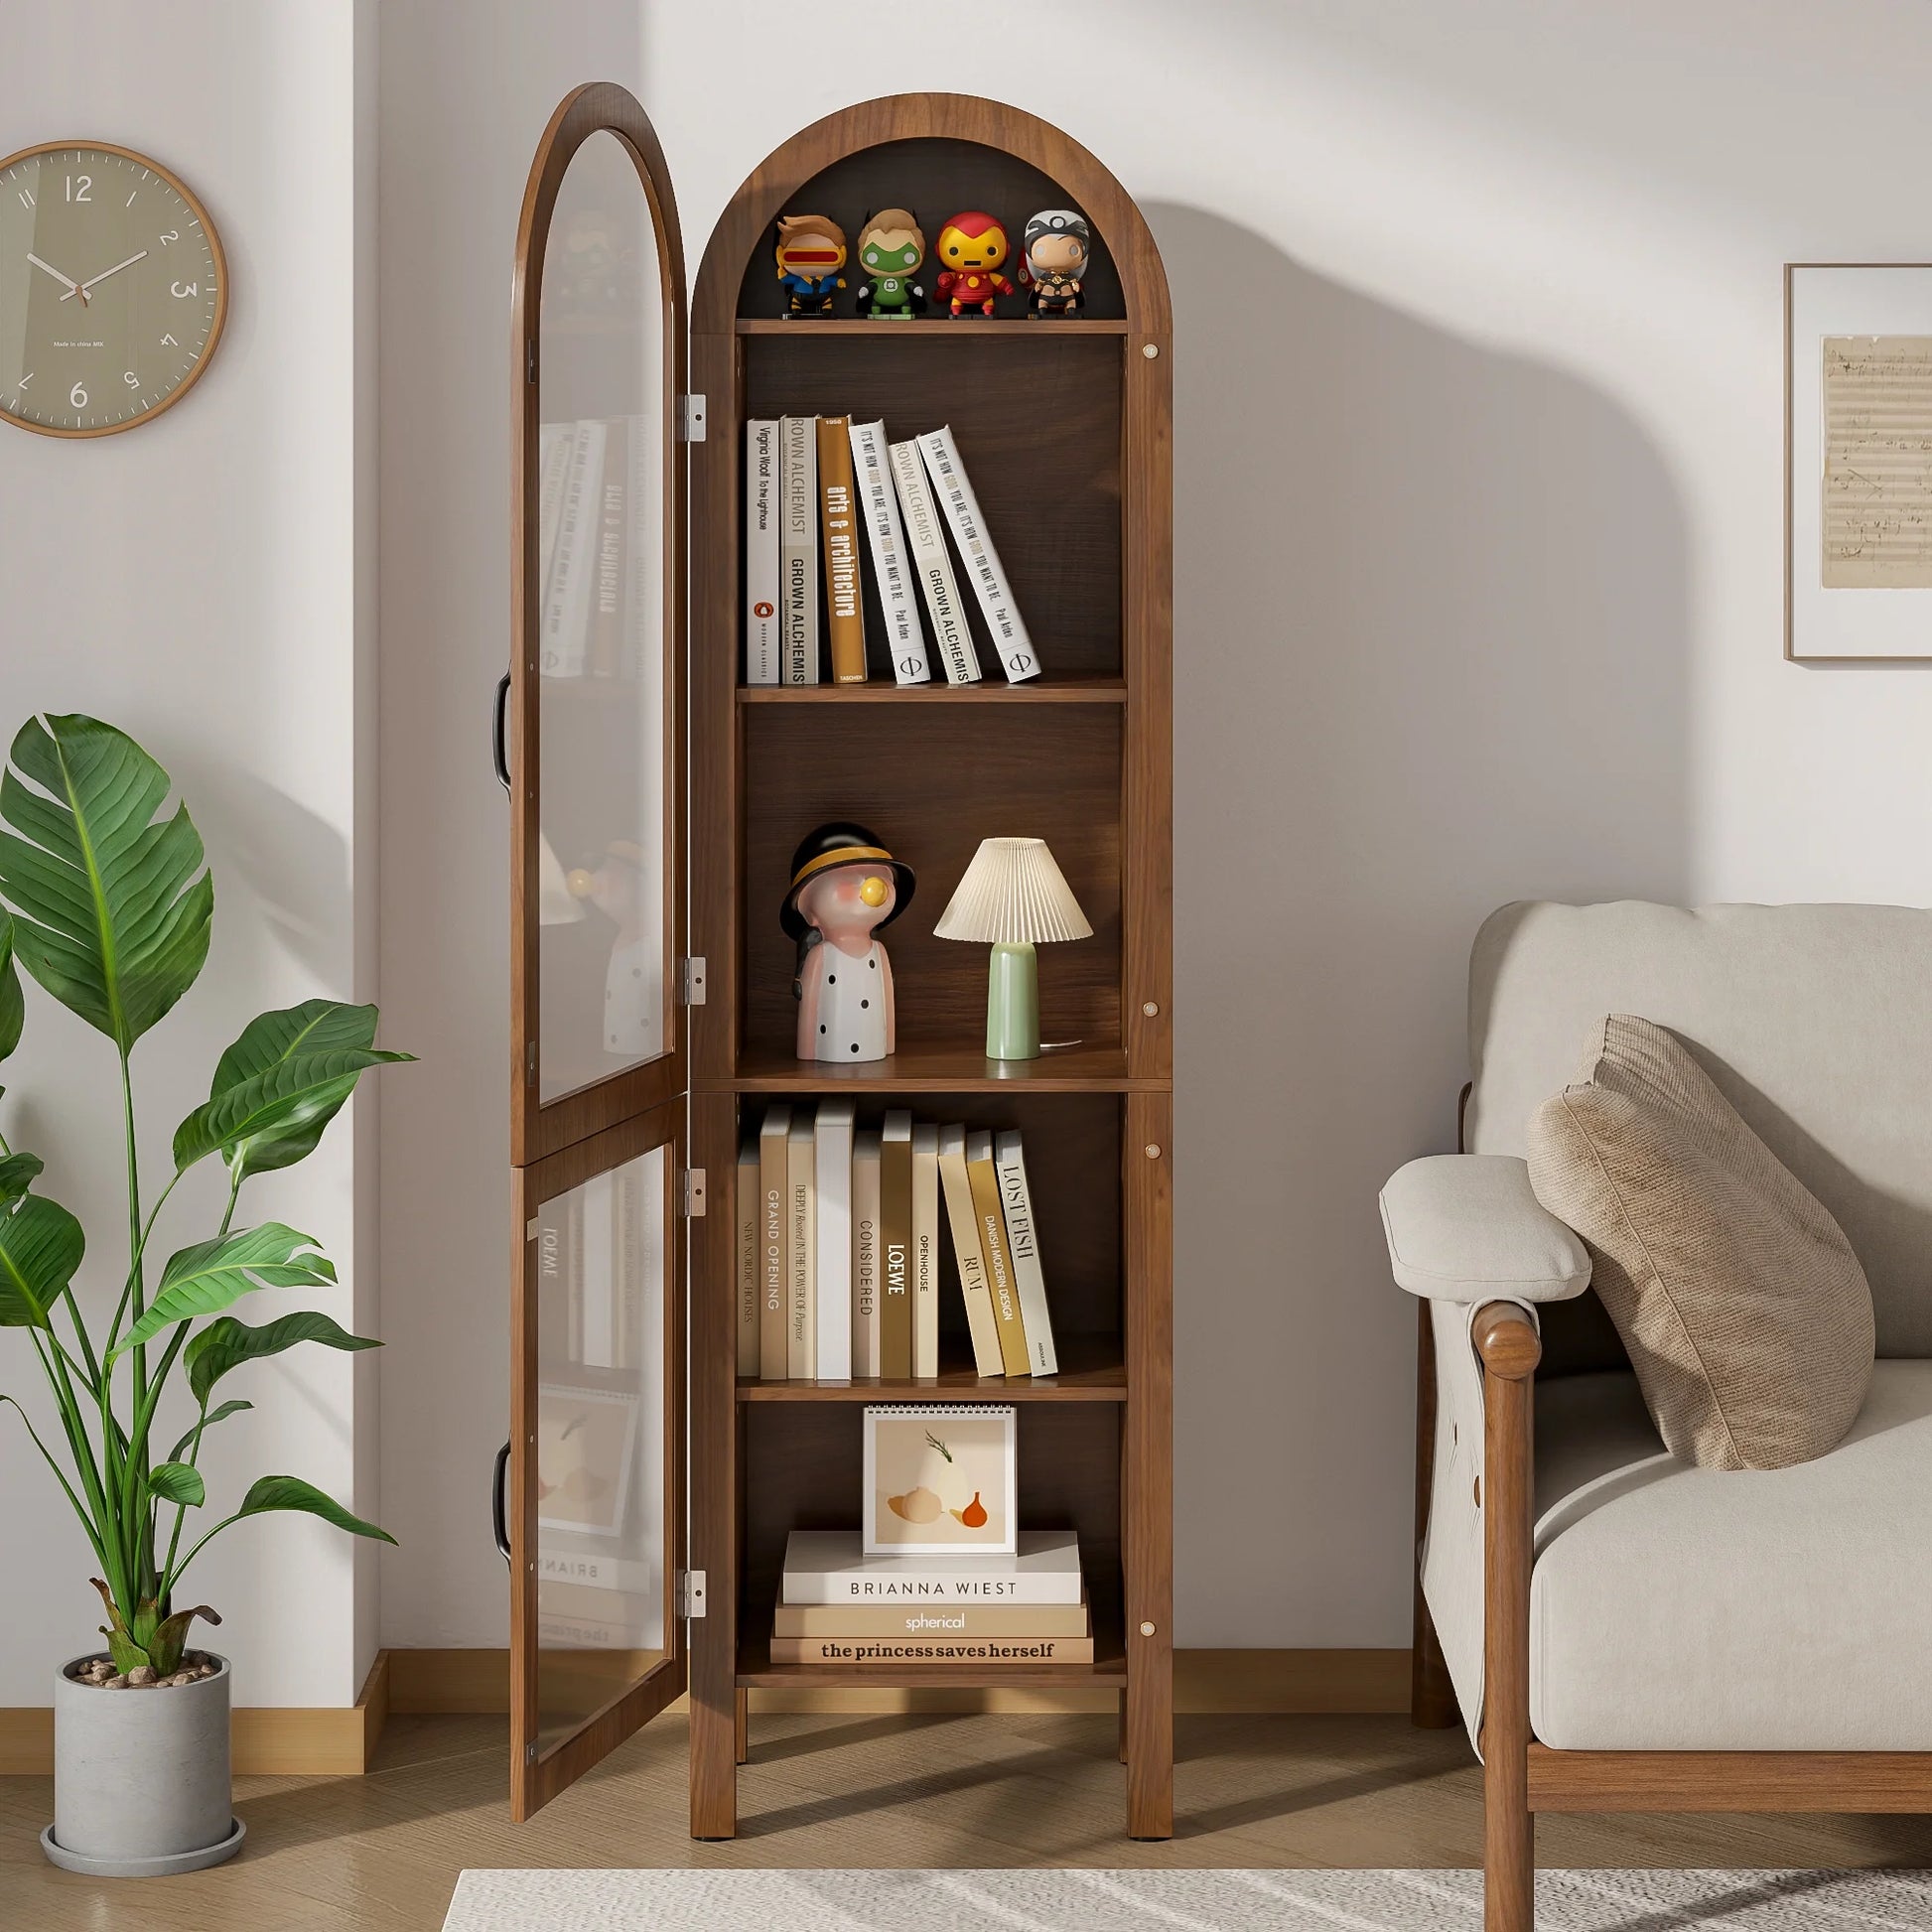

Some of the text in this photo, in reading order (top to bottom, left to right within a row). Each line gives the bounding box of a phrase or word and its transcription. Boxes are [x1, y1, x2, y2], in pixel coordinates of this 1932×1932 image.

[66, 175, 92, 203] 12
[18, 189, 36, 209] 11
[126, 191, 137, 207] 1
[159, 230, 179, 246] 2
[170, 281, 198, 299] 3
[160, 333, 179, 346] 4
[18, 372, 35, 390] 7
[123, 371, 140, 389] 5
[69, 381, 88, 408] 6
[756, 427, 770, 455] Virginia
[863, 443, 876, 454] NOT
[866, 455, 878, 469] HOW
[896, 443, 912, 481] ROWN
[933, 450, 948, 463] NOT
[759, 456, 770, 477] Woolf
[939, 462, 953, 475] HOW
[791, 418, 806, 534] ROWN ALCHEMIST
[868, 469, 881, 484] GOOD
[759, 488, 769, 497] the
[827, 485, 851, 513] arts
[871, 485, 884, 497] YOU
[950, 490, 963, 502] YOU
[757, 498, 769, 530] Lighthouse
[903, 483, 934, 548] ALCHEMIST
[879, 524, 892, 536] HOW
[963, 527, 977, 540] HOW
[881, 538, 895, 553] GOOD
[884, 554, 897, 565] YOU
[975, 556, 987, 568] YOU
[830, 534, 856, 617] architecture
[888, 566, 899, 582] WANT
[979, 568, 994, 584] WANT
[791, 558, 805, 684] GROWN ALCHEMIS
[895, 610, 909, 639] Paul Arden
[929, 569, 970, 684] GROWN ALCHEMIS
[995, 608, 1014, 639] Paul Arden
[795, 1184, 806, 1213] DEEPLY
[1003, 1166, 1035, 1260] LOST FISH
[795, 1215, 806, 1241] Rooted
[767, 1189, 779, 1311] GRAND OPENING
[795, 1241, 806, 1250] IN
[795, 1251, 806, 1267] THE
[860, 1220, 874, 1315] CONSIDERED
[919, 1235, 928, 1293] OPENHOUSE
[985, 1215, 1014, 1320] DANISH MODERN DESIGN
[888, 1244, 905, 1296] LOEWE
[963, 1256, 983, 1291] RUM
[795, 1269, 806, 1298] POWER
[795, 1300, 806, 1311] OF
[850, 1583, 1017, 1594] BRIANNA WIEST
[905, 1613, 965, 1631] spherical
[822, 1644, 1054, 1661] the princess saves herself
